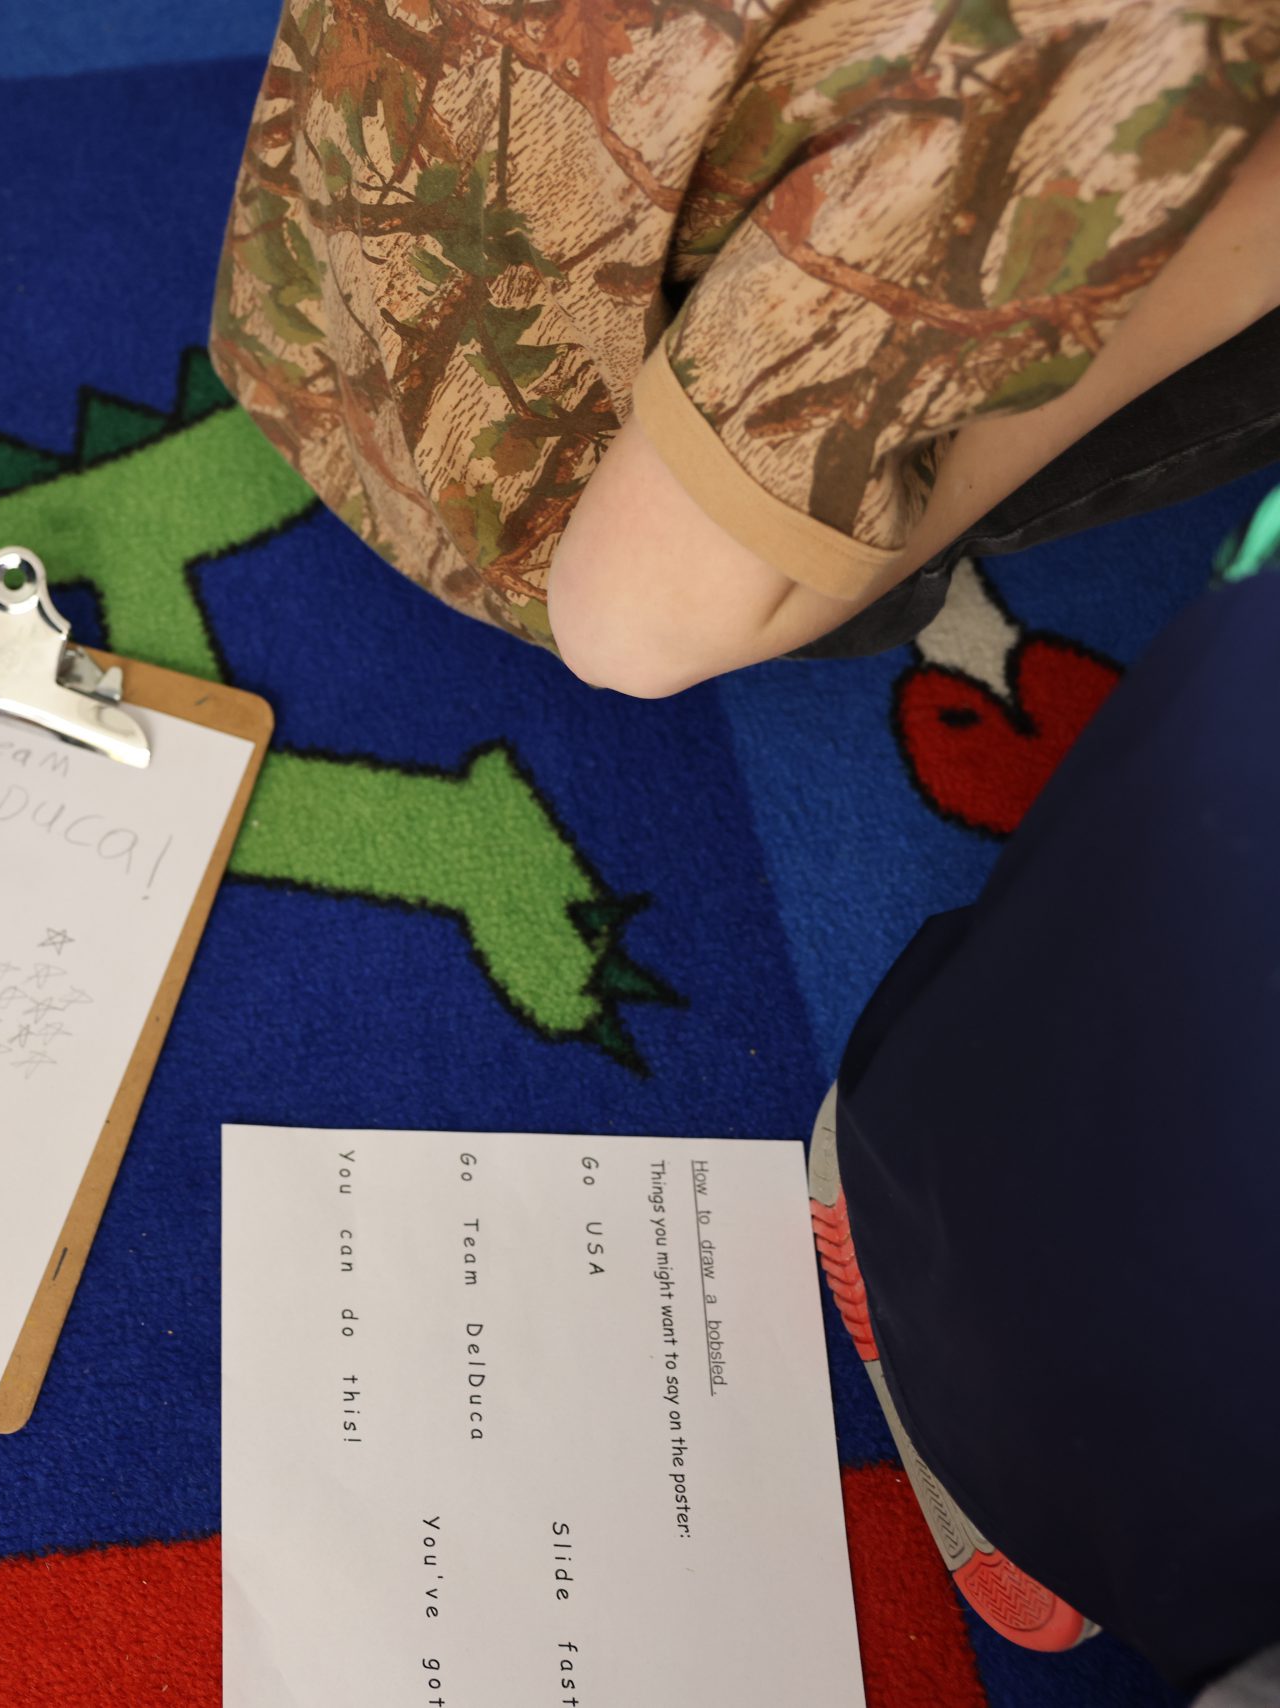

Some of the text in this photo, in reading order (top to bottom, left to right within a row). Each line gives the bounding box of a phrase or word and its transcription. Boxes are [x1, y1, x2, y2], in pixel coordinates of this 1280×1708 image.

[581, 1157, 605, 1275] Go USA
[693, 1160, 710, 1196] How
[698, 1209, 711, 1226] to
[339, 1150, 362, 1442] You can do this!
[460, 1153, 486, 1439] Go Team DelDuca
[701, 1239, 717, 1280] draw
[705, 1293, 718, 1305] a
[648, 1160, 691, 1538] Things you might want to say on the poster:
[422, 1516, 445, 1708] You've got
[552, 1521, 580, 1708] Slide fast
